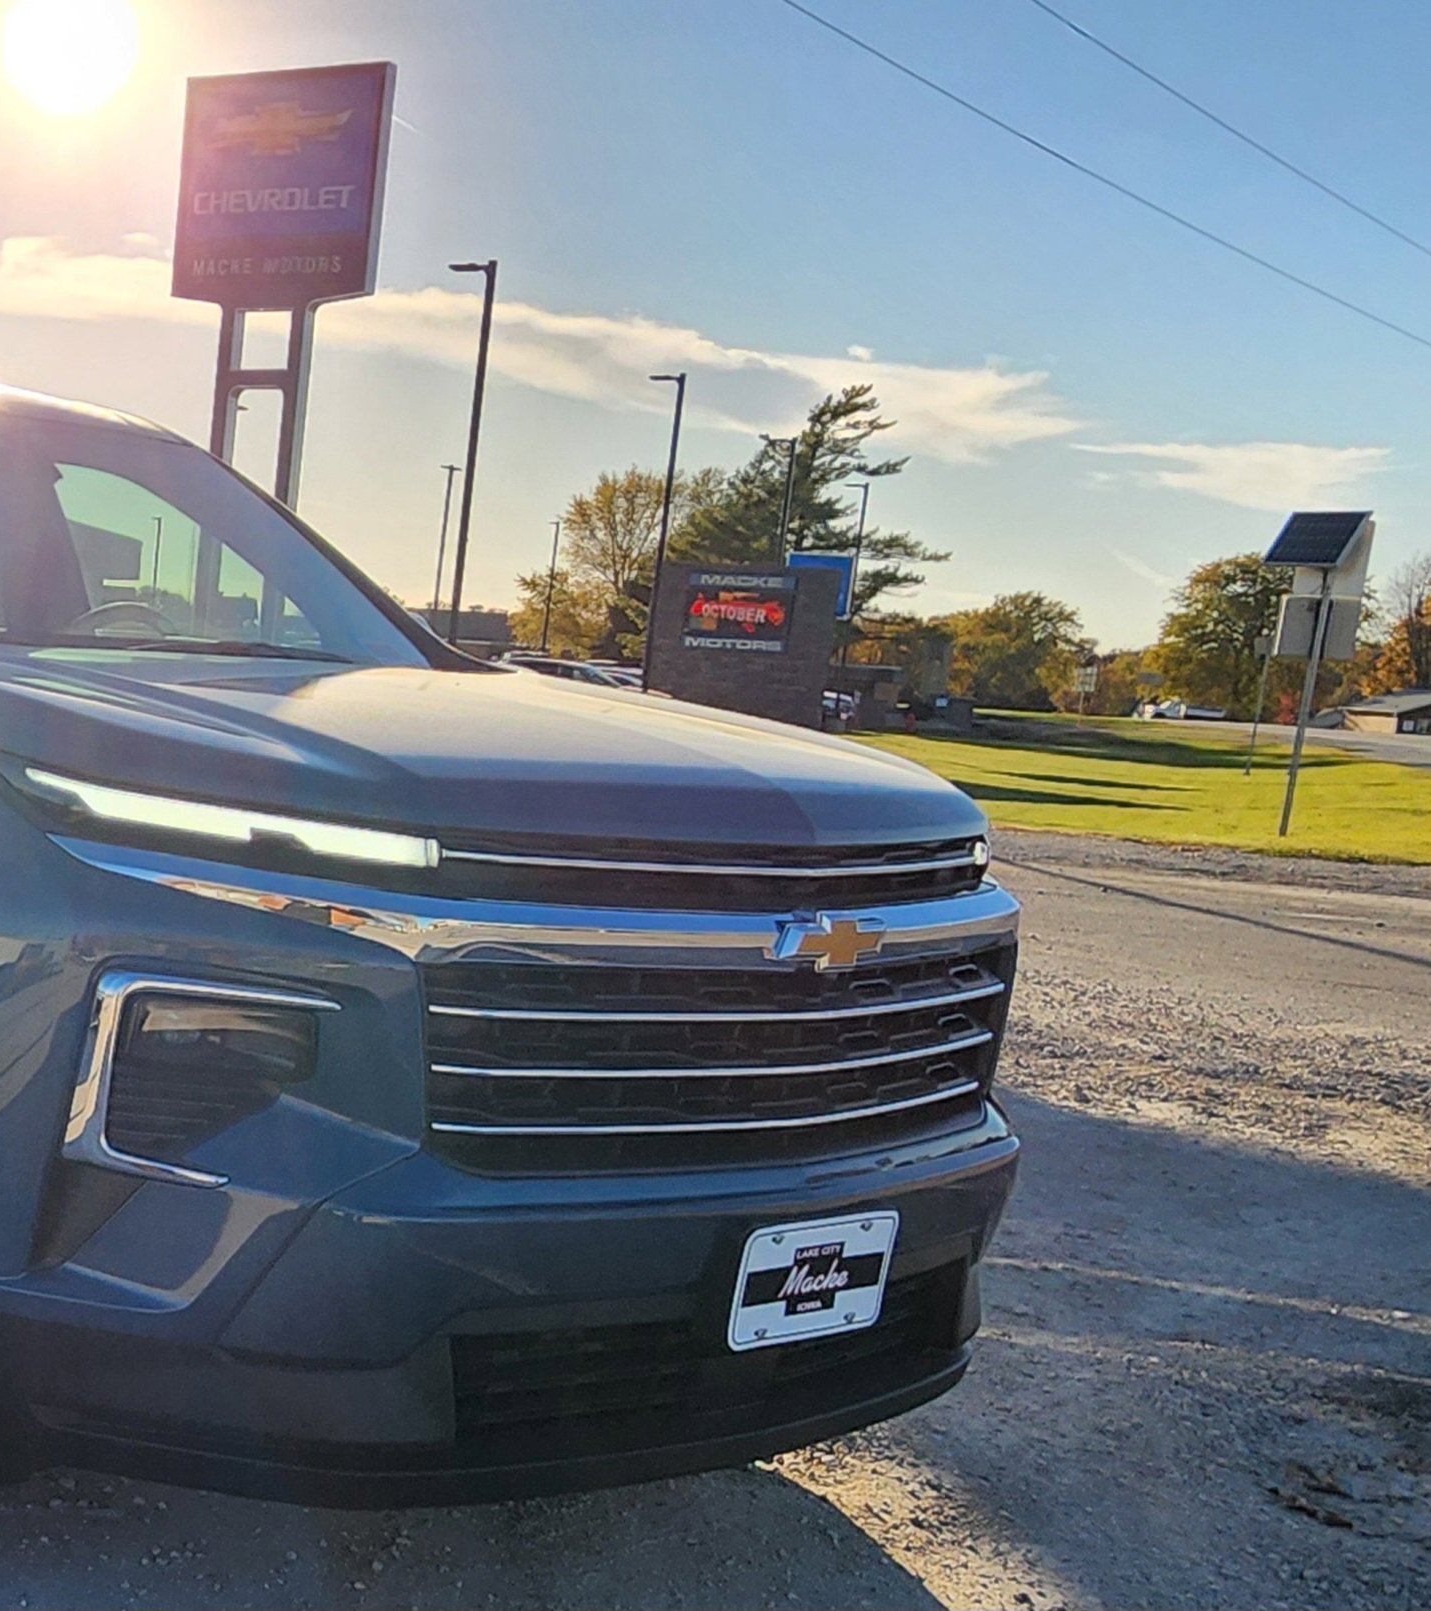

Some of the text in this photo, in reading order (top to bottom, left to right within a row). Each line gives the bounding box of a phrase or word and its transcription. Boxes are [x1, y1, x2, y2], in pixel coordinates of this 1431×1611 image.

[193, 185, 355, 215] CHEVROLET
[192, 255, 342, 276] MACKE MOTORS
[700, 574, 783, 588] MACKE
[701, 603, 766, 624] OCTOBER
[684, 636, 782, 651] MOTORS
[796, 1245, 841, 1260] LAKE CITY
[777, 1258, 849, 1298] Macke
